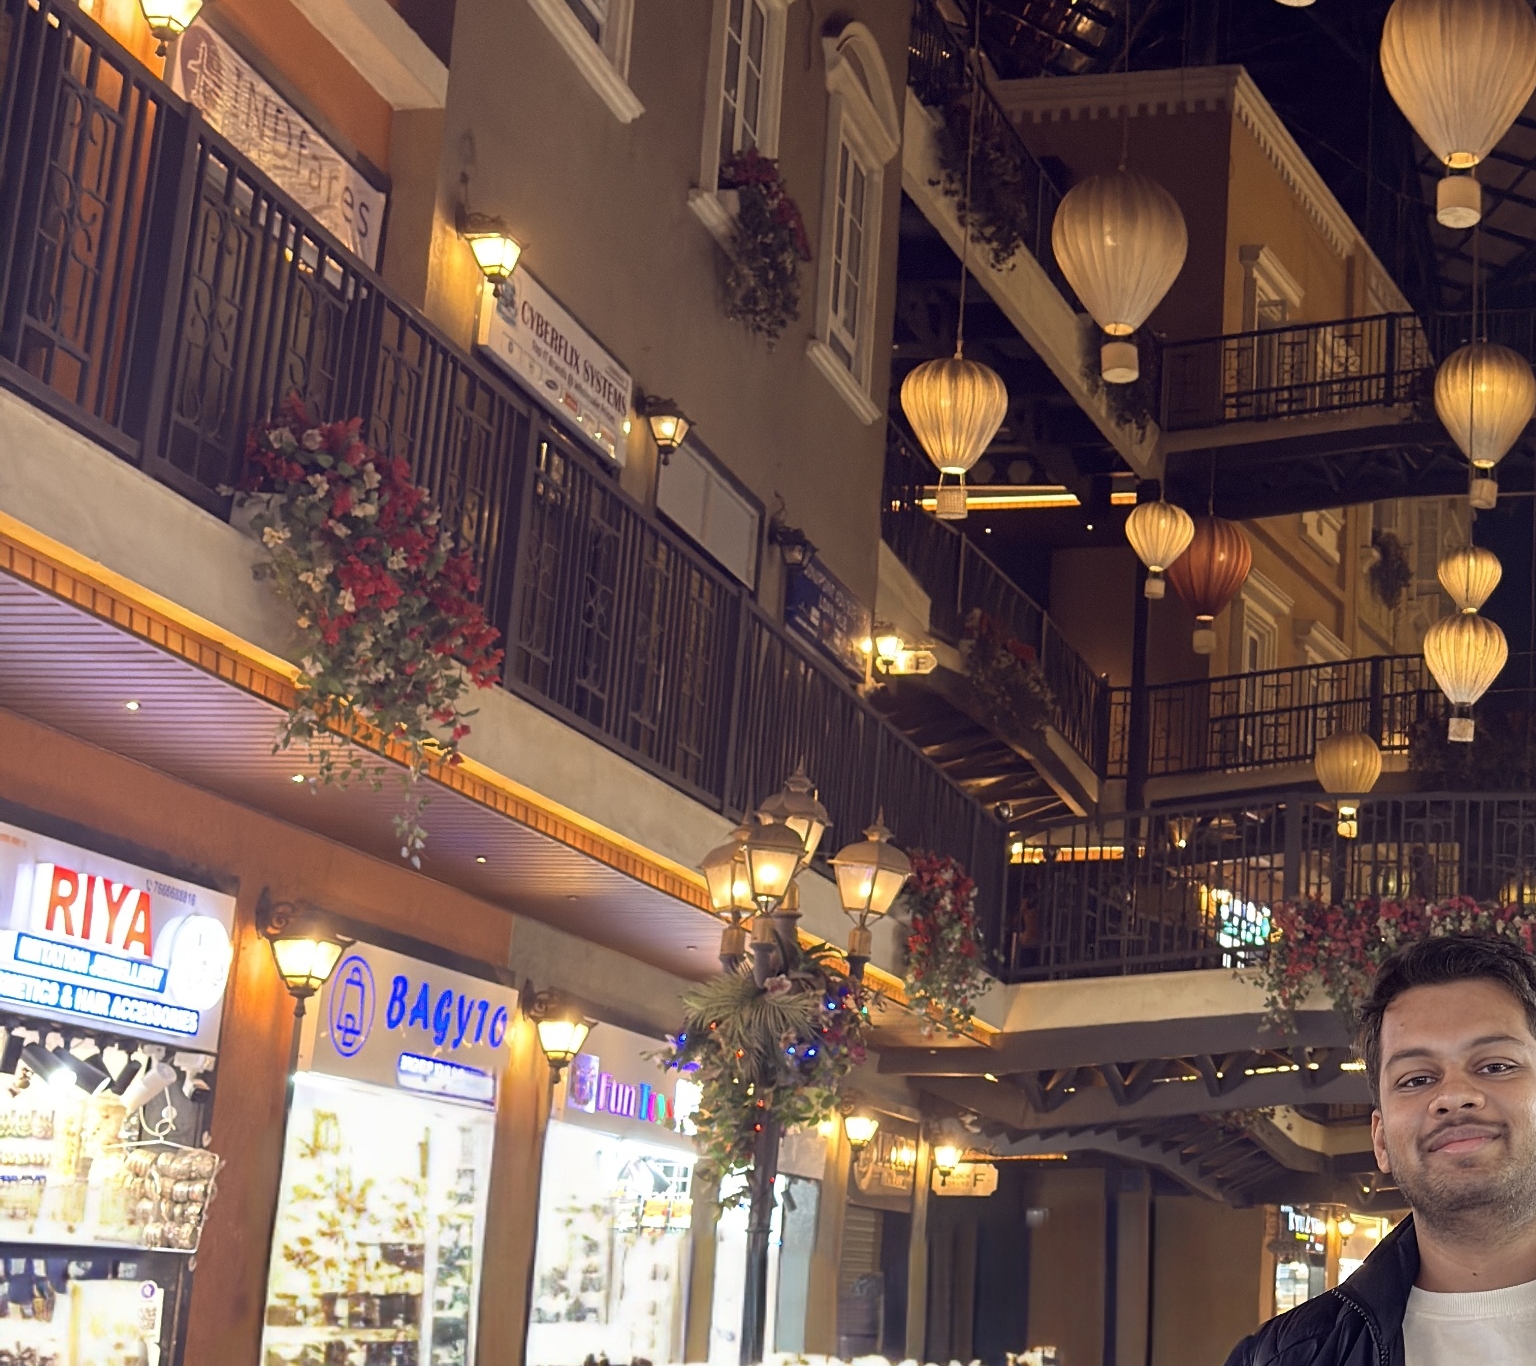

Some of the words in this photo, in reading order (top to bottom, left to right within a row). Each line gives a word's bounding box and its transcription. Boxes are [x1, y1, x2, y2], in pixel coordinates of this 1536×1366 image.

[583, 359, 627, 417] SYSTEMS
[44, 864, 153, 959] RIYA
[597, 1072, 636, 1118] Fun
